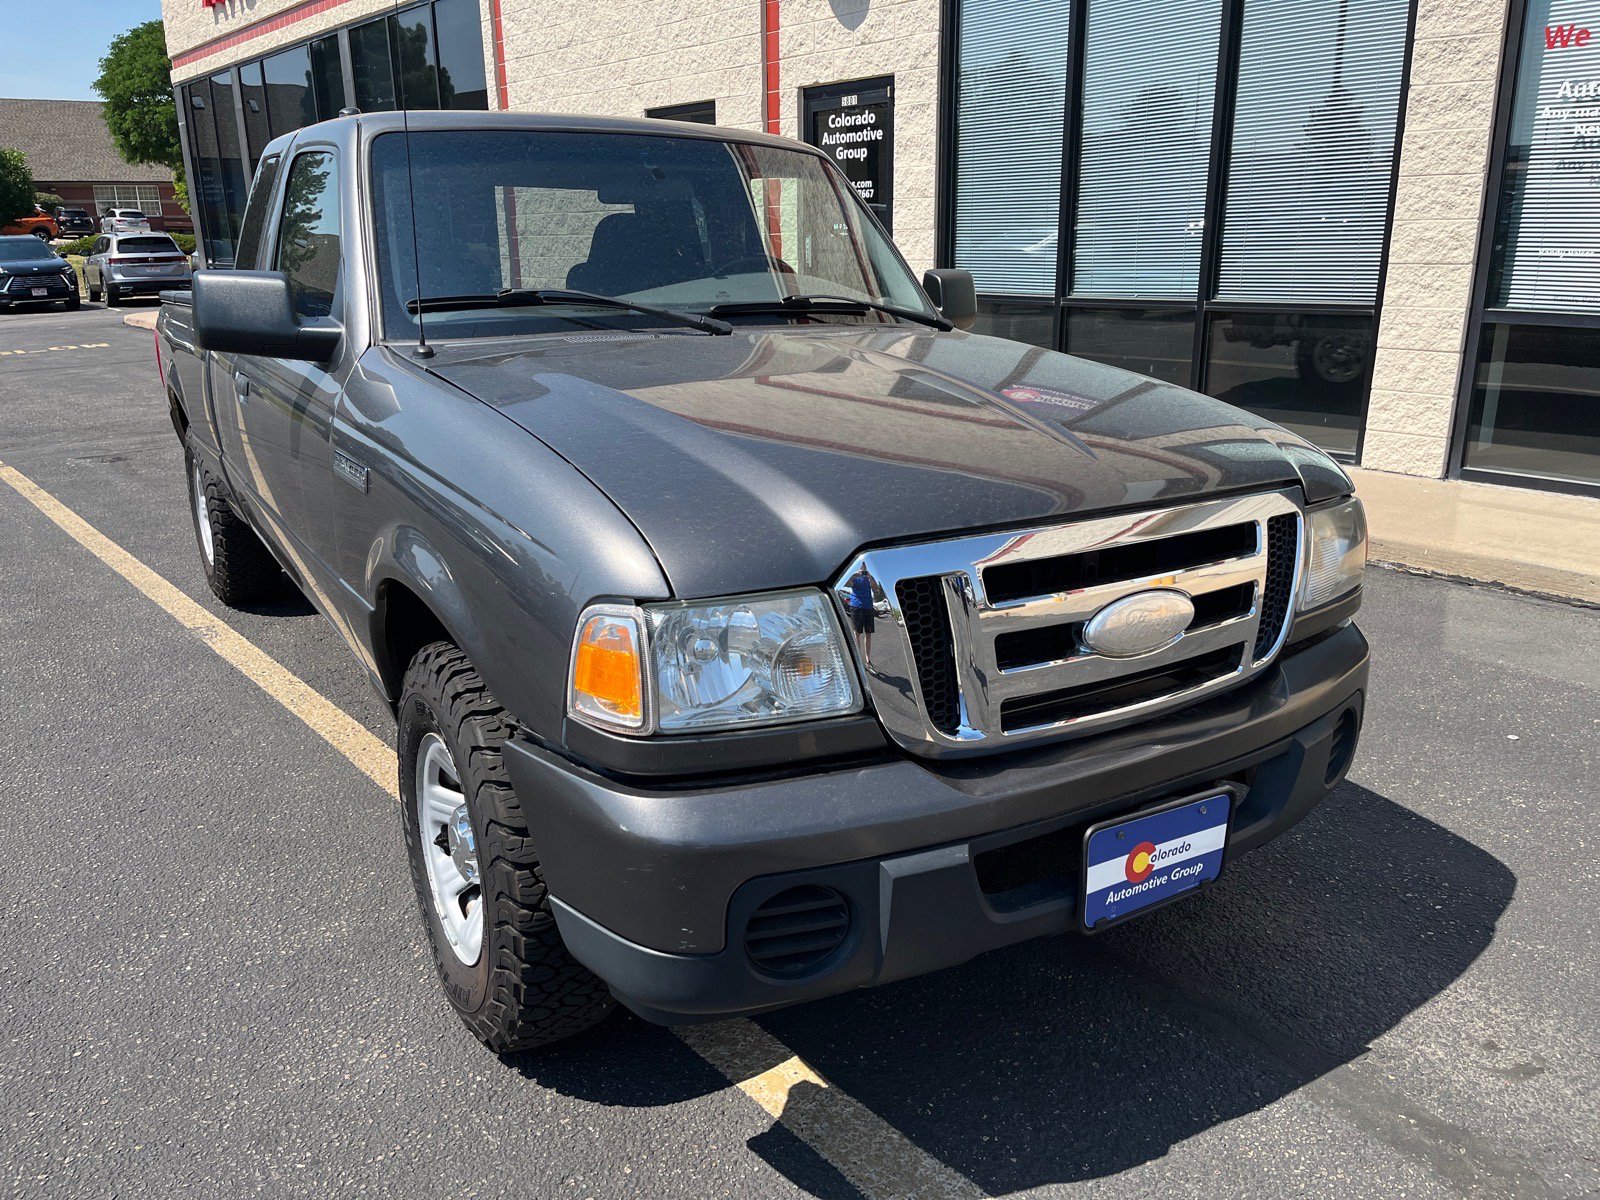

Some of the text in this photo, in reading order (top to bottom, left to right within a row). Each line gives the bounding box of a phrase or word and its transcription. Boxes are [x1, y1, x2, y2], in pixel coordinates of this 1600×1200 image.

[1545, 24, 1592, 49] We
[828, 110, 876, 128] Colorado
[1541, 107, 1570, 120] Any
[822, 127, 883, 145] Automotive
[1574, 124, 1600, 136] Ne
[836, 147, 868, 161] Group
[851, 180, 873, 189] s.com
[857, 189, 875, 198] 7667
[1125, 841, 1192, 884] Colorado
[1105, 876, 1168, 906] Automotive
[1171, 862, 1204, 881] Group
